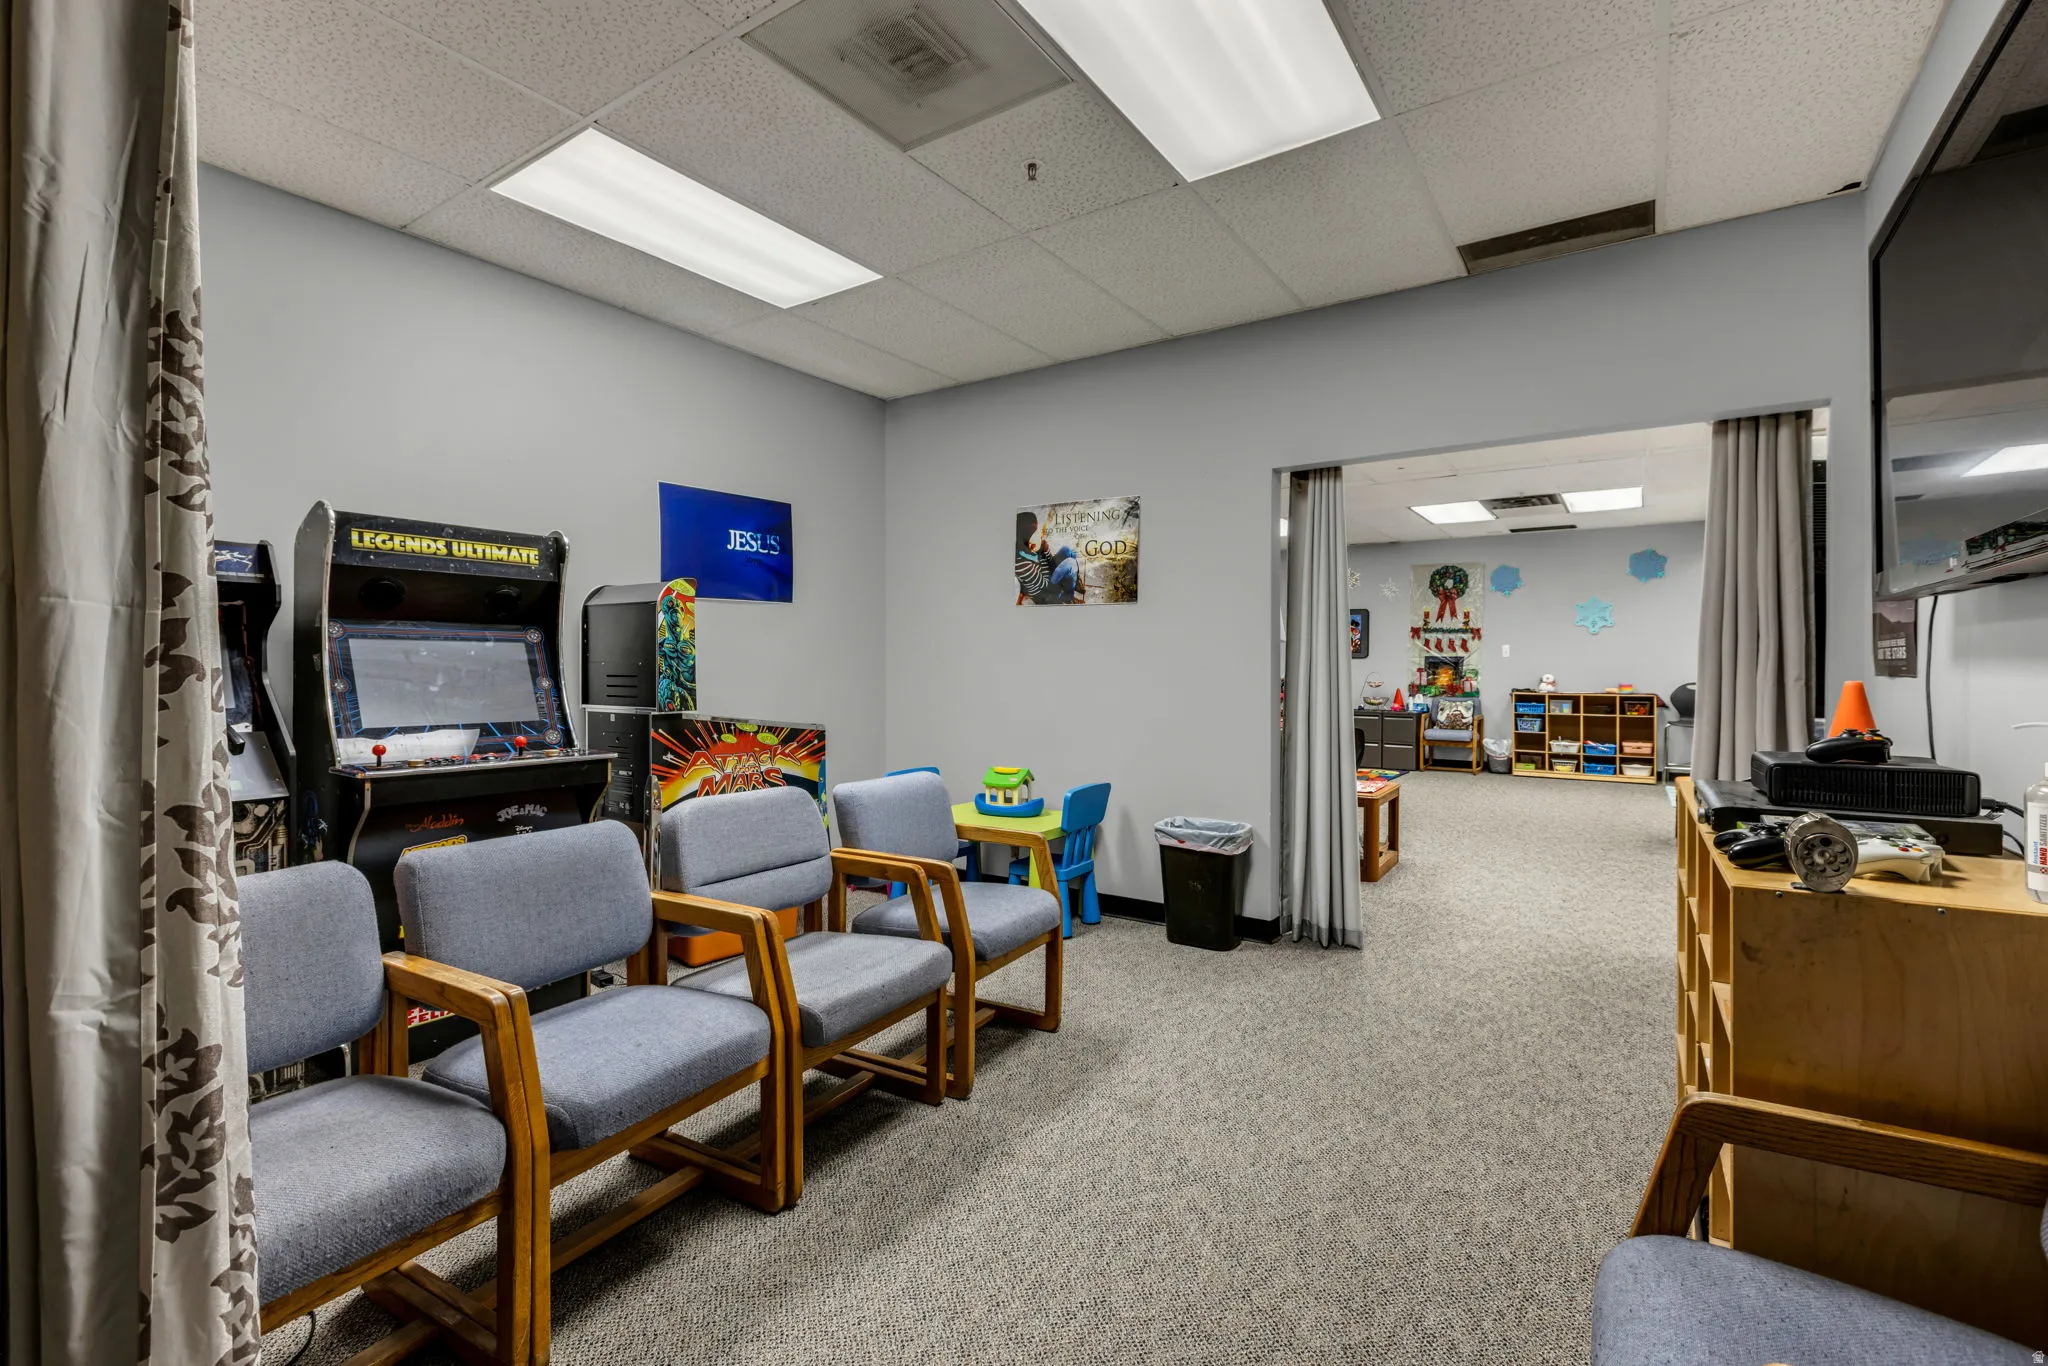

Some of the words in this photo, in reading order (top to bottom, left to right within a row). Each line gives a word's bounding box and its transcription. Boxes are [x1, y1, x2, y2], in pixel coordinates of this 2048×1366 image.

[1054, 510, 1121, 525] LISTENING
[351, 531, 448, 555] LEGENDS
[452, 541, 540, 565] ULTIMATE
[727, 529, 780, 555] JESUS
[1085, 540, 1127, 557] GOD
[682, 742, 801, 778] ATTACK
[733, 764, 761, 777] from
[696, 767, 788, 798] MARS
[409, 814, 465, 833] Aladdin
[2039, 847, 2047, 865] HAND
